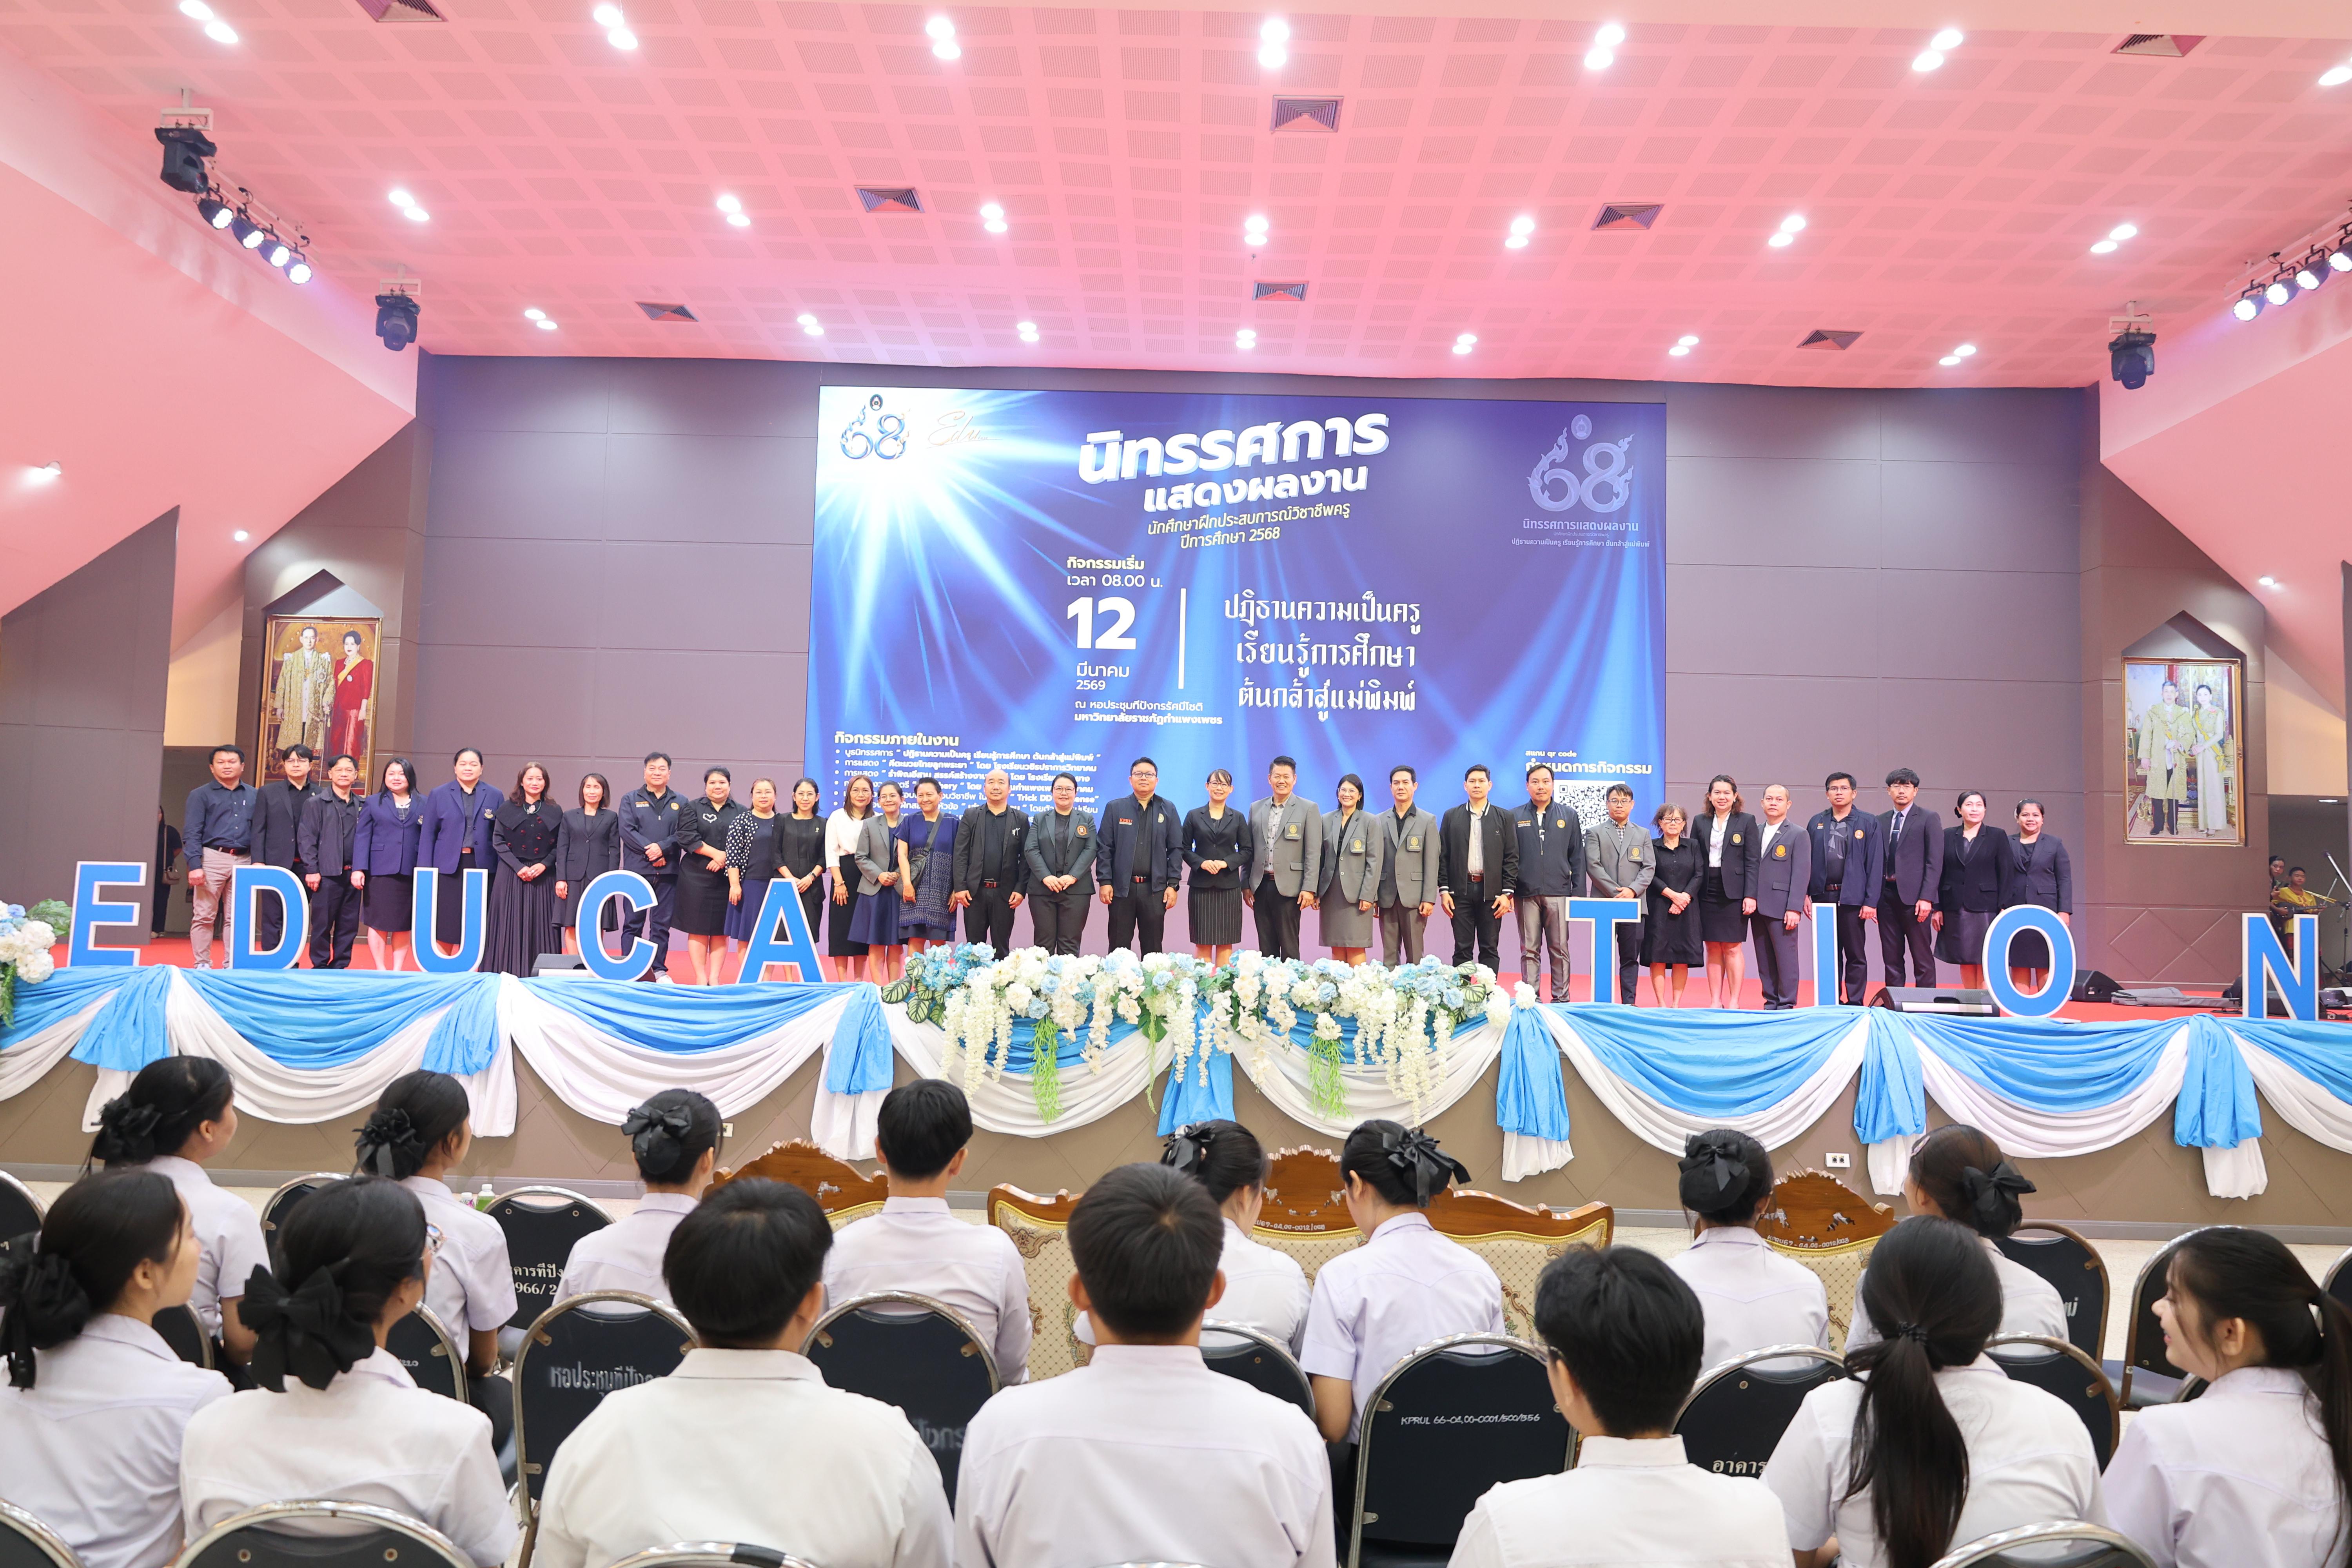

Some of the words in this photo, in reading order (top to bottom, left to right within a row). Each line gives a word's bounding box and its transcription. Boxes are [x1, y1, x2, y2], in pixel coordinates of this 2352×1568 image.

[1078, 412, 1389, 485] นิทรรศการ
[1143, 466, 1368, 512] แสดงผลงาน
[1147, 502, 1350, 535] นักศึกษาฝึกประสบการณ์วิชาชีพครู
[1523, 518, 1639, 531] นิทรรศการแสดงผลงาน
[1180, 529, 1245, 549] ปีการศึกษา
[1249, 527, 1281, 543] 2568
[1067, 554, 1145, 570] กิจกรรมเริ่ม
[1067, 575, 1096, 586] เวลา
[1102, 574, 1145, 587] 08.00
[1151, 577, 1163, 588] น.
[1067, 597, 1136, 650] 12
[1237, 630, 1415, 679] เรียนรู้การศึกษา
[1076, 661, 1130, 677] มีนาคม
[1076, 679, 1106, 690] 2569
[1075, 701, 1086, 709] ณ
[1238, 677, 1416, 722] ต้นกล้าสู่แม่พิมพ์
[834, 731, 960, 746] กิจกรรมภายในงาน
[845, 748, 894, 758] บูธนิทรรศการ
[1010, 773, 1026, 781] โดย
[966, 782, 982, 790] โดย
[1017, 793, 1038, 802] Trick
